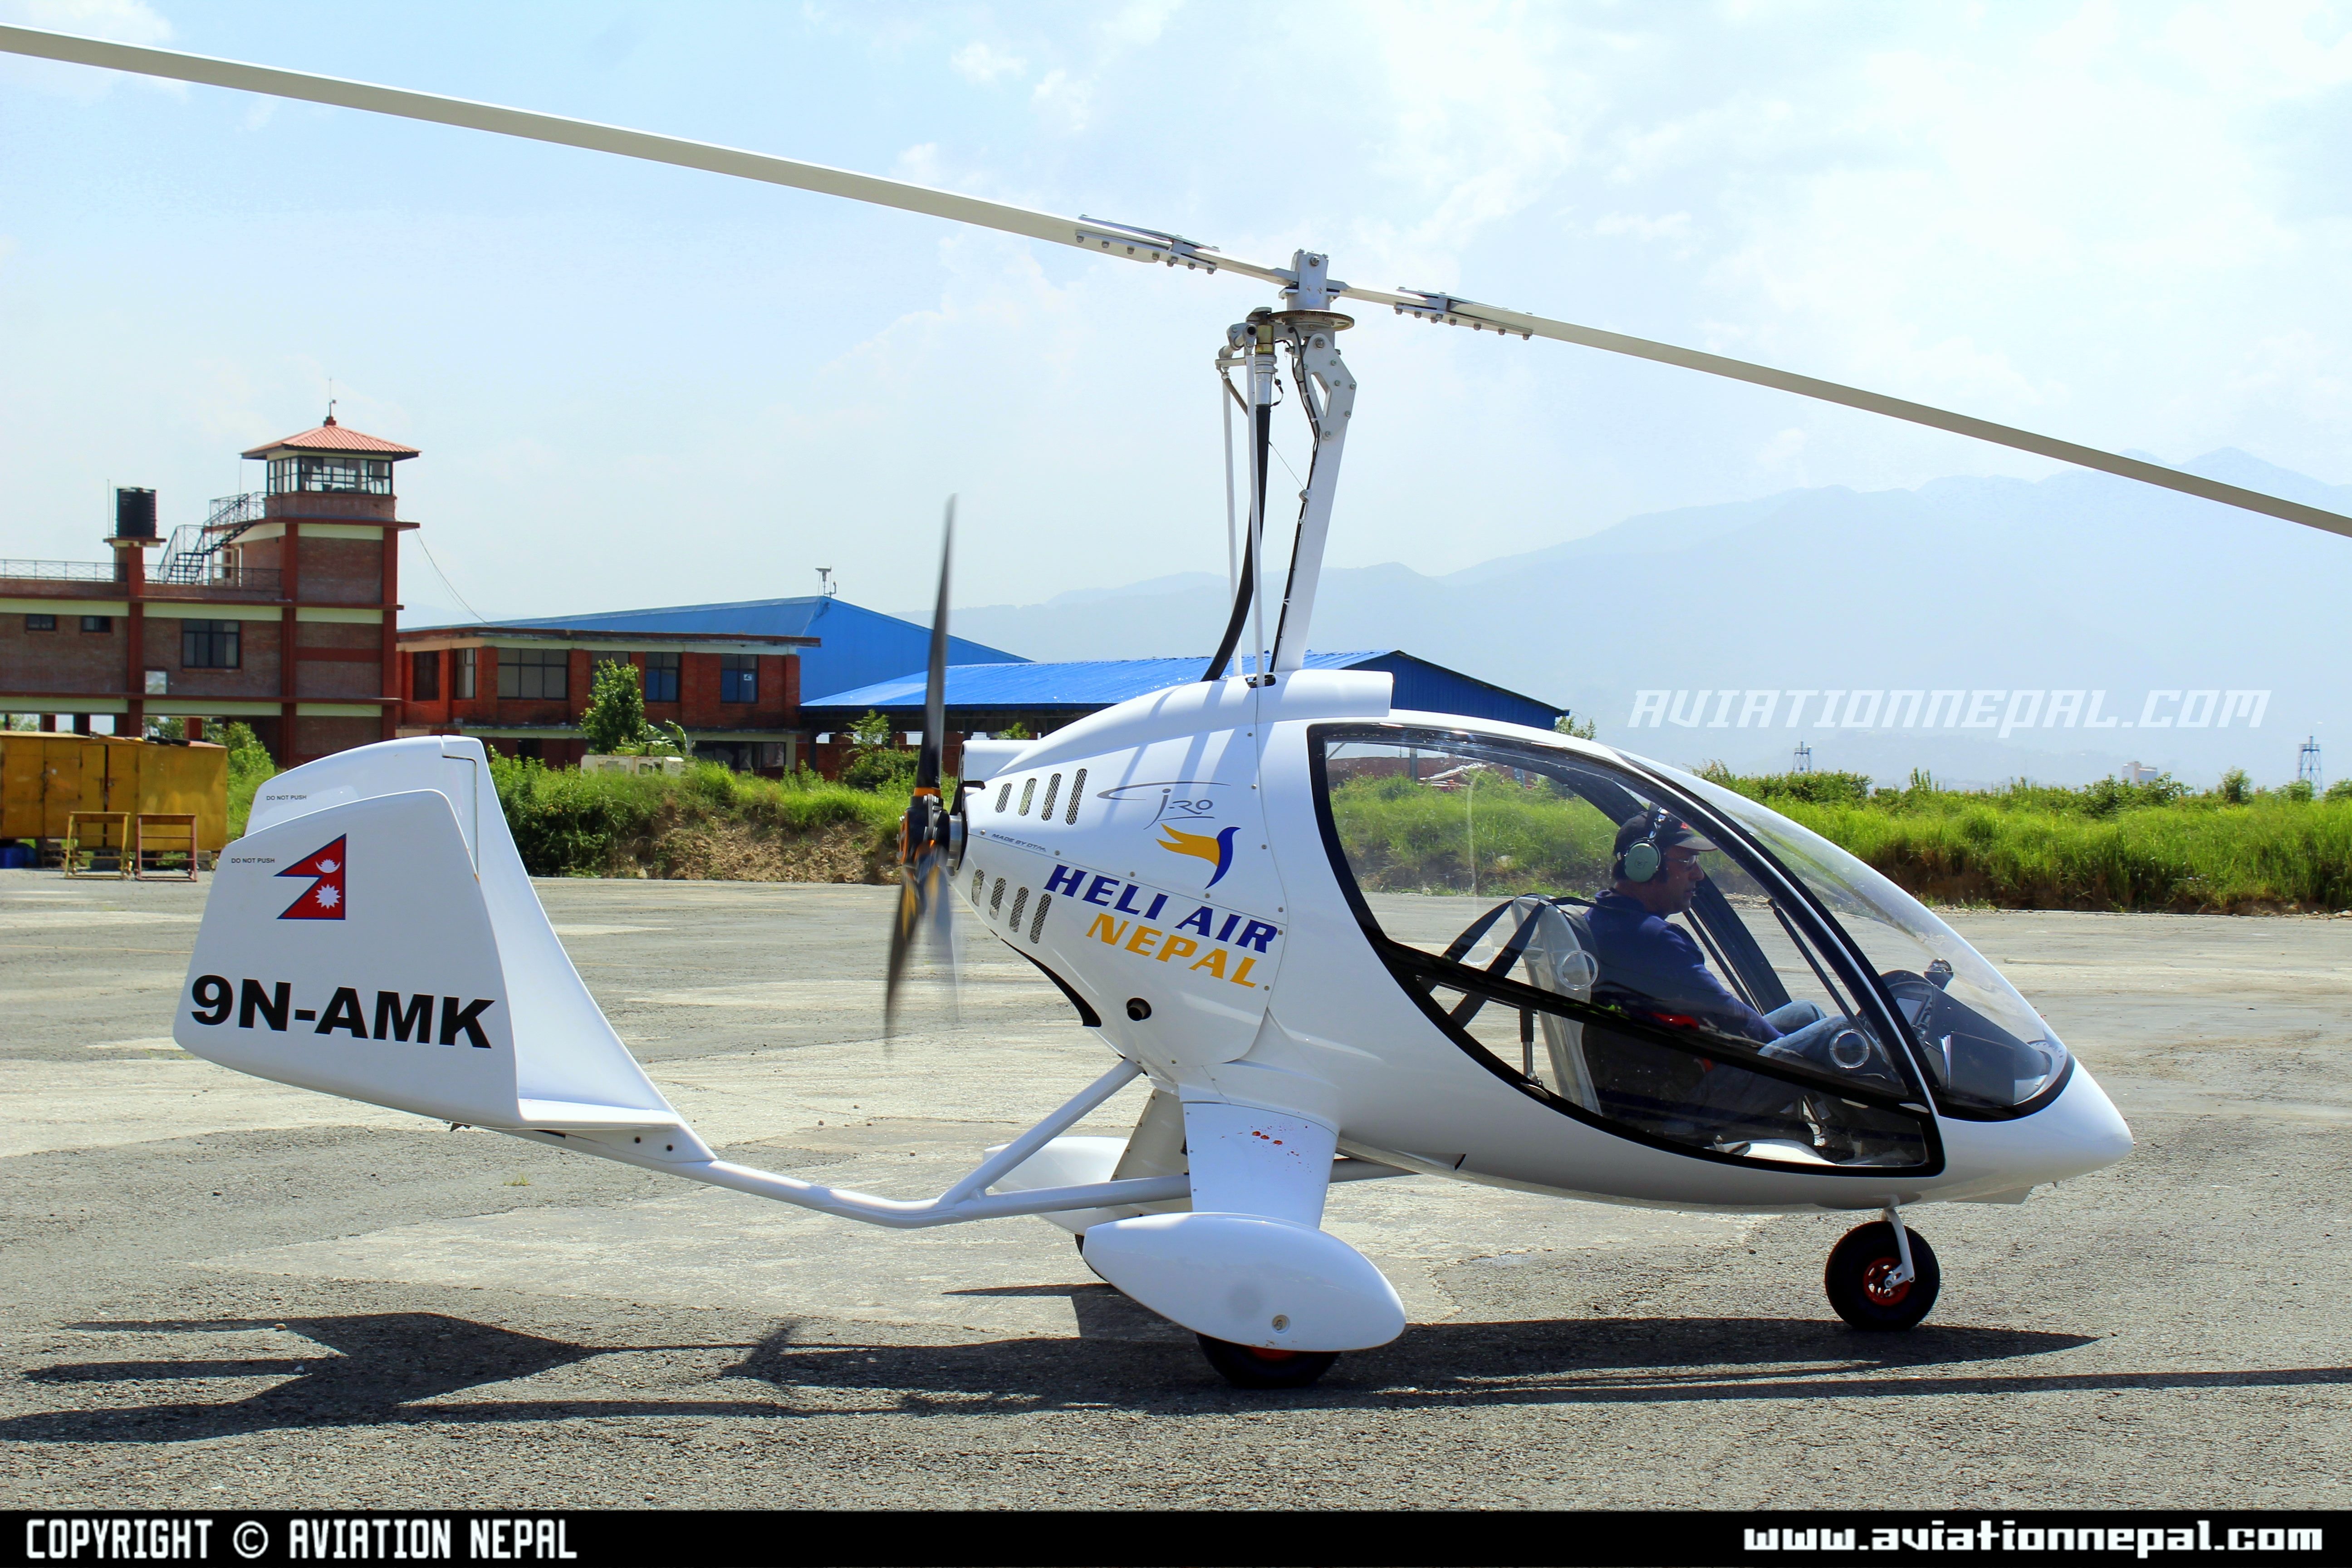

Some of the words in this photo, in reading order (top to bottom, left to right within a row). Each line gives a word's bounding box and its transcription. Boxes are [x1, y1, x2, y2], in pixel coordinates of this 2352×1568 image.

[991, 833, 1015, 843] MADE
[1044, 864, 1169, 921] HELI
[1175, 906, 1278, 954] AIR
[1086, 913, 1257, 988] NEPAL
[191, 975, 495, 1049] 9N-AMK
